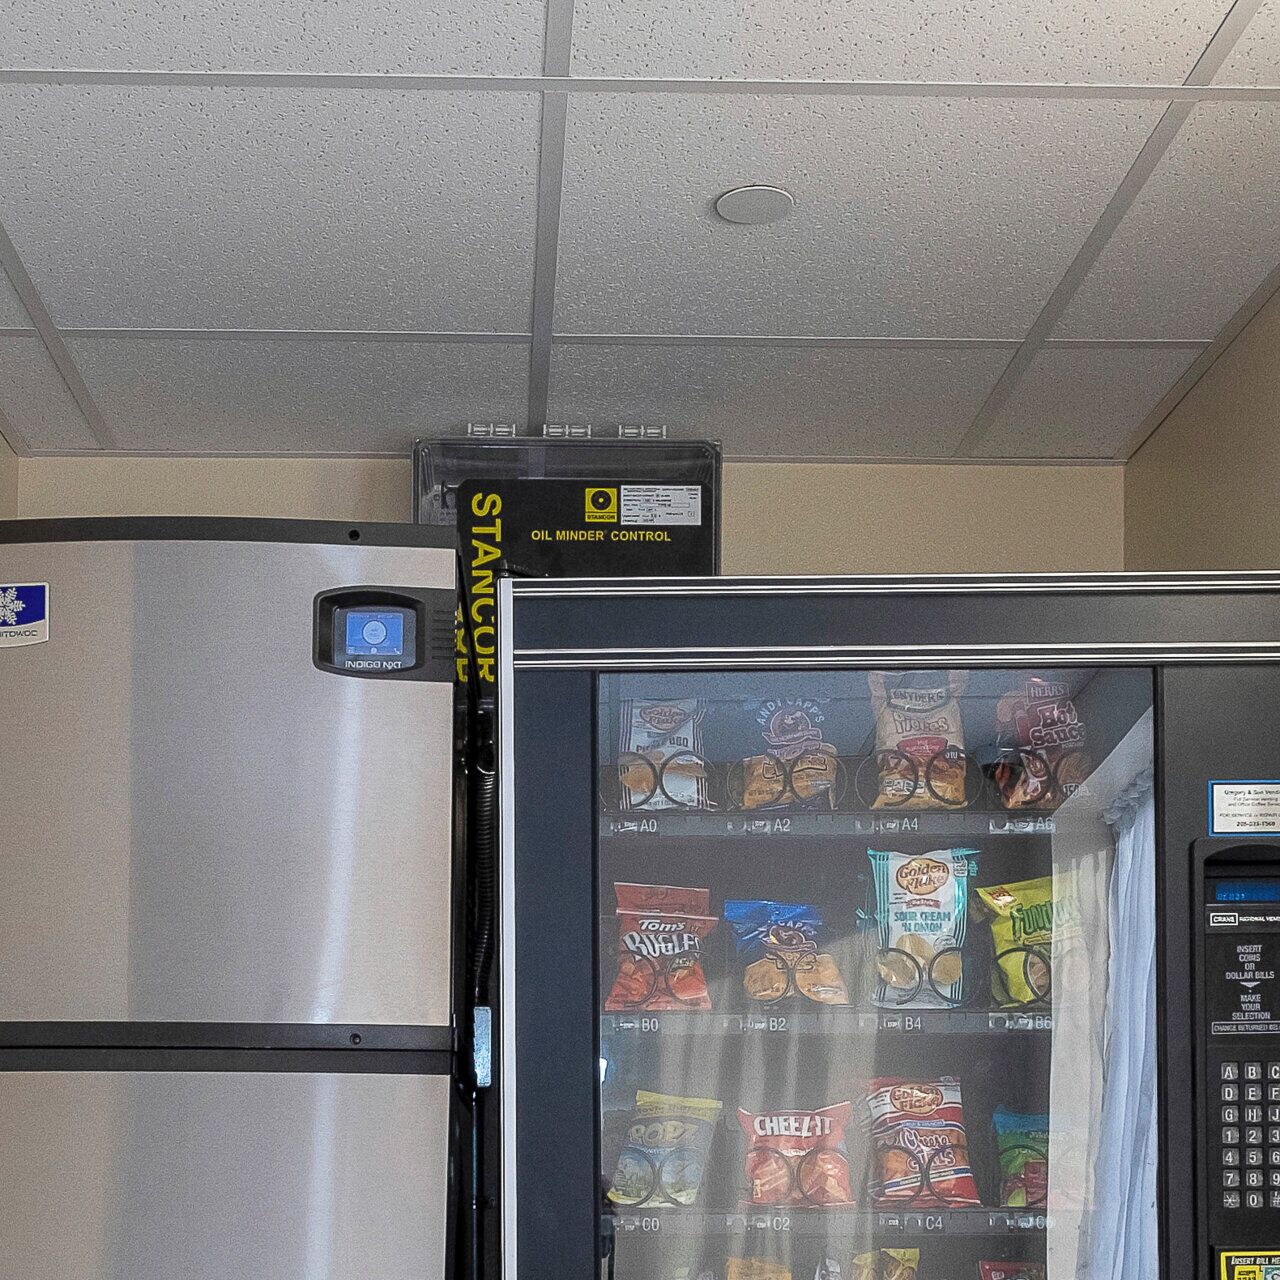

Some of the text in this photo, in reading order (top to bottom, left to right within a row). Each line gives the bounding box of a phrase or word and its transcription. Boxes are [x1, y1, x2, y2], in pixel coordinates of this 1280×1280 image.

[531, 529, 672, 542] OIL MINDER CONTROL
[345, 660, 381, 669] INDIGO
[640, 819, 657, 832] A0
[773, 818, 791, 832] A2
[901, 817, 919, 831] A4
[899, 863, 947, 879] Golden
[894, 911, 951, 922] SOUR CREAM
[638, 919, 686, 931] Tom's
[1236, 944, 1262, 953] INSERT
[1238, 953, 1261, 962] COINS
[1244, 962, 1255, 971] OR
[1225, 971, 1275, 980] DOLLAR BILLS
[1240, 994, 1262, 1002] MAKE
[1241, 1003, 1261, 1011] YOUR
[1231, 1011, 1271, 1020] SELECTION
[641, 1018, 659, 1031] B0
[770, 1018, 787, 1031] B2
[905, 1016, 921, 1030] B4
[1035, 1016, 1053, 1029] B6
[1214, 1024, 1237, 1032] CHANGE
[1224, 1065, 1280, 1078] A B C
[1224, 1087, 1280, 1099] D E F
[1225, 1108, 1279, 1120] G H J
[1226, 1129, 1280, 1142] 1 2 3
[1225, 1151, 1280, 1163] 4 5 6
[1226, 1173, 1280, 1185] 7 8 9
[1249, 1194, 1257, 1206] 0
[641, 1217, 660, 1231] C0
[773, 1217, 790, 1231] C2
[925, 1216, 943, 1230] C4
[1231, 1256, 1254, 1265] INSERT
[1255, 1256, 1269, 1265] BILL
